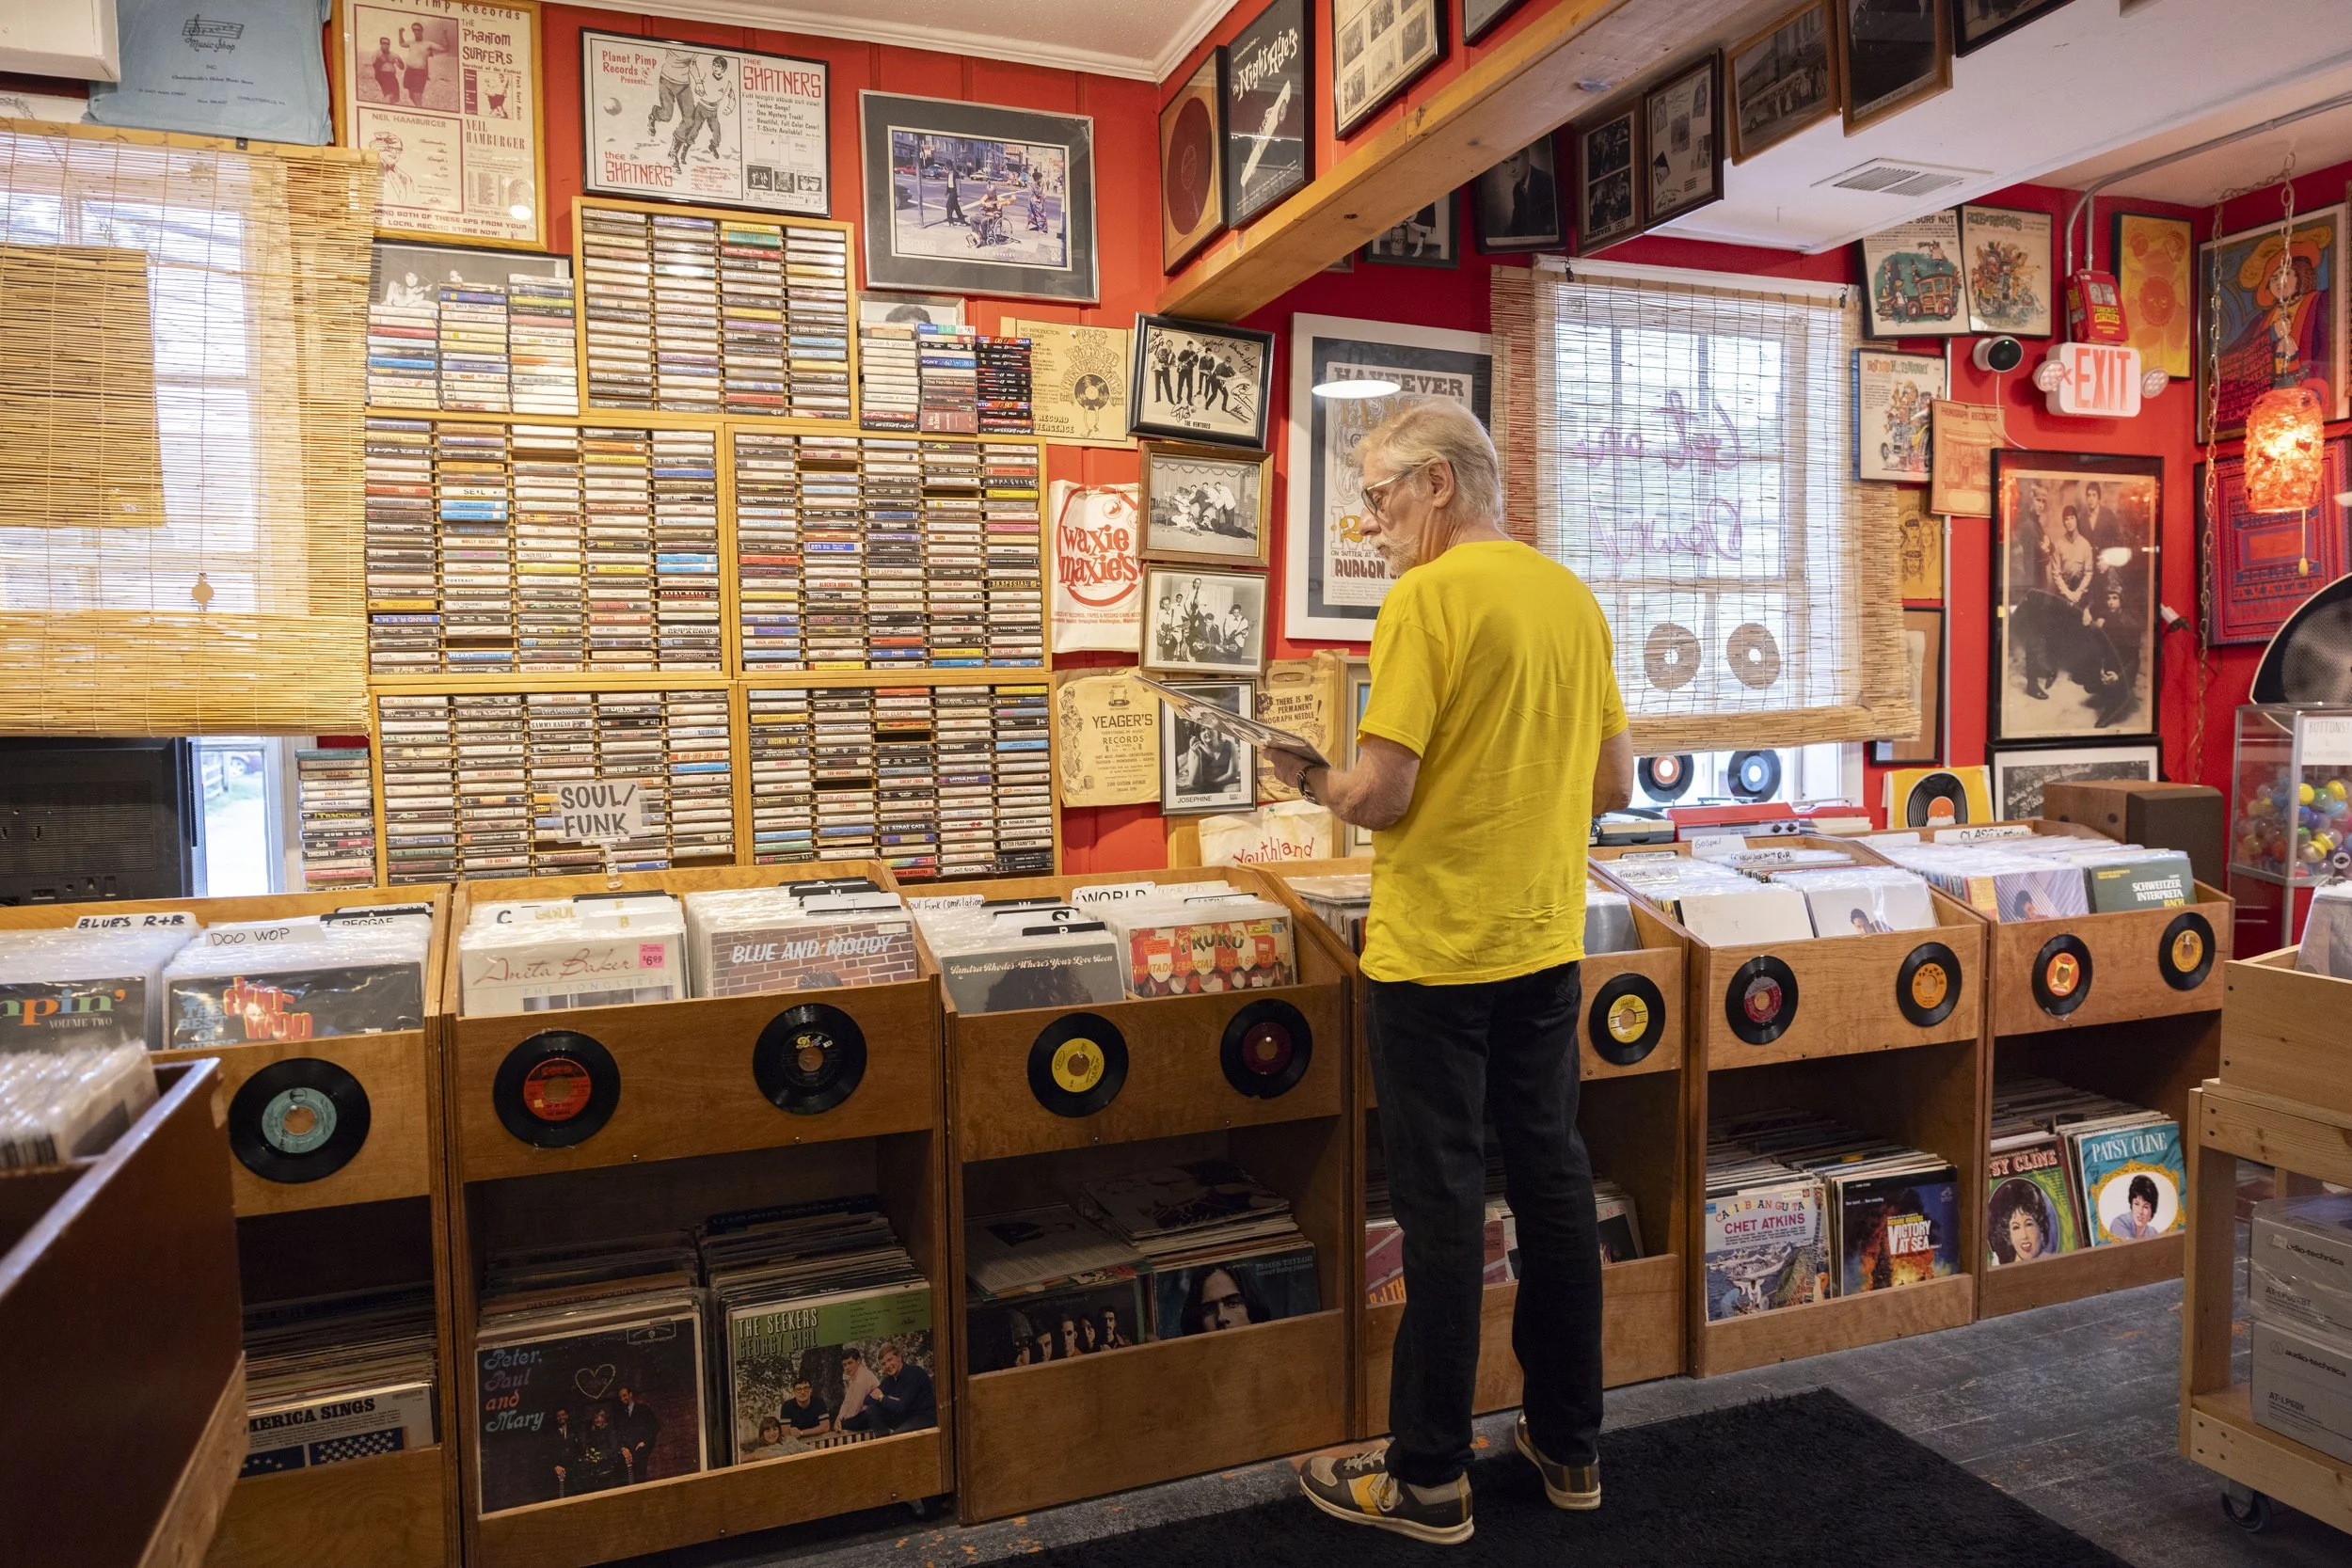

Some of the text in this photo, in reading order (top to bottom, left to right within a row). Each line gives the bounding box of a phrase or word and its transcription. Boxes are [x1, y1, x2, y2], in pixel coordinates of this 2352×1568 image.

[462, 5, 520, 20] Records
[602, 50, 658, 70] Planet Pimp
[1238, 26, 1298, 102] Night Riders
[603, 62, 639, 76] Records
[743, 66, 821, 99] SHATNERS
[756, 102, 791, 112] Twelve Songs!
[768, 110, 787, 120] Mystery
[788, 112, 803, 120] Track!
[372, 109, 447, 129] NEIL HAMBURGER
[466, 119, 487, 132] NEIL
[791, 120, 803, 129] Color
[756, 125, 803, 136] T-Shirts Available!
[466, 132, 525, 150] HAMBURGER
[606, 161, 673, 187] SHATNERS
[389, 219, 413, 229] LOCAL
[452, 225, 477, 233] STORE
[436, 215, 459, 224] THESE
[463, 217, 478, 226] EPS
[1915, 215, 1954, 224] SURF NUT
[2074, 347, 2131, 411] EXIT
[1039, 415, 1070, 423] RECORD
[1192, 420, 1211, 429] VENTURES
[1061, 524, 1130, 556] waxie
[1059, 552, 1137, 588] maxie's
[1277, 697, 1293, 705] THERE
[1278, 703, 1312, 714] PERMANENT
[1092, 714, 1152, 728] YEAGER'S
[1295, 711, 1314, 721] NEEDLE
[531, 721, 551, 729] SAMMY
[1103, 736, 1144, 744] RECORDS
[561, 784, 636, 810] SOUL/
[1177, 796, 1212, 804] JOSEPHINE
[564, 813, 629, 838] FUNK
[1694, 837, 1722, 849] Gospel
[2132, 879, 2182, 892] SCHWEITZER
[2137, 889, 2185, 901] INTERPRETA
[2163, 898, 2185, 907] BACH
[78, 915, 132, 929] BLUES
[211, 927, 290, 946] DOO WOP
[1177, 927, 1245, 955] FRUKO
[732, 935, 894, 963] BLUE AND MOODY
[473, 947, 633, 986] Anita Baker
[1073, 955, 1092, 966] Love
[1093, 954, 1113, 963] Been
[1176, 958, 1215, 972] ESPECIAL
[522, 974, 675, 996] THE SONGSTRESS
[184, 1006, 223, 1019] THE
[49, 1016, 112, 1028] VOLUME TWO
[179, 1017, 228, 1031] BEST
[2091, 1132, 2169, 1164] PATSY CLINE
[2013, 1149, 2058, 1172] CLINE
[1724, 1212, 1805, 1234] CHET ATKINS
[1887, 1220, 1931, 1256] VICTORY
[1899, 1235, 1931, 1255] AT SEA
[738, 1317, 760, 1338] THE
[768, 1308, 818, 1335] SEEKERS
[739, 1327, 818, 1359] GEORGY GIRL
[484, 1348, 543, 1370] Peter,
[2284, 1348, 2347, 1379] audio-technica
[485, 1368, 532, 1392] Paul
[485, 1390, 519, 1411] and
[321, 1398, 376, 1420] SINGS
[485, 1410, 546, 1433] Mary
